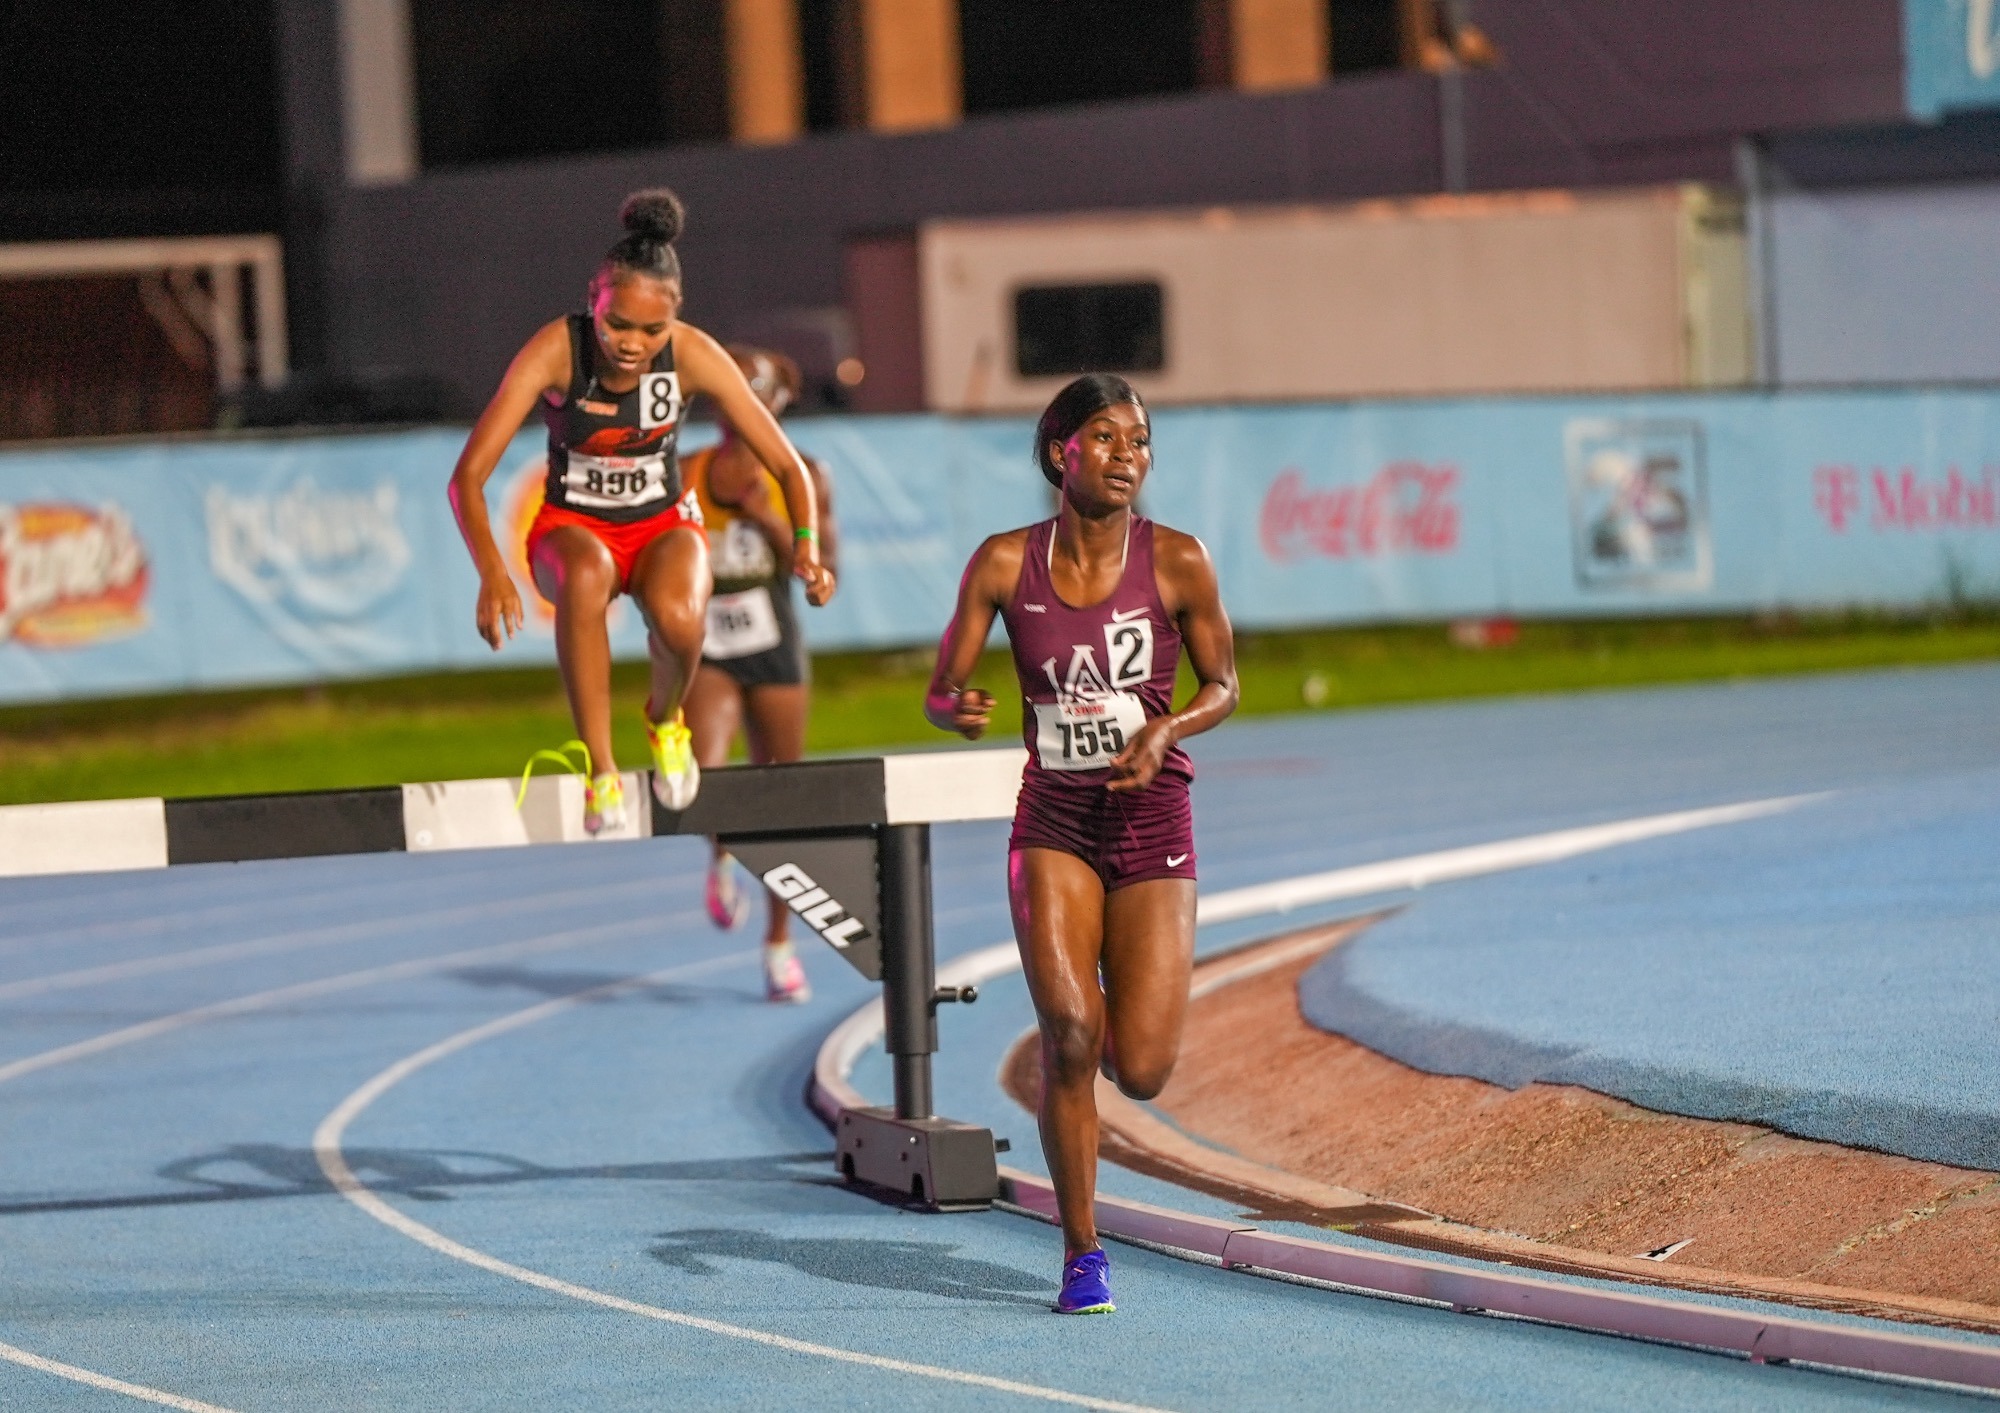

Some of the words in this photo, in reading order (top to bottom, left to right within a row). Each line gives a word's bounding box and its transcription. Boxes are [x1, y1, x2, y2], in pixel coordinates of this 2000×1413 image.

[650, 376, 672, 422] 8
[1114, 627, 1144, 681] 2
[1055, 716, 1125, 758] 755
[762, 862, 866, 949] GILL
